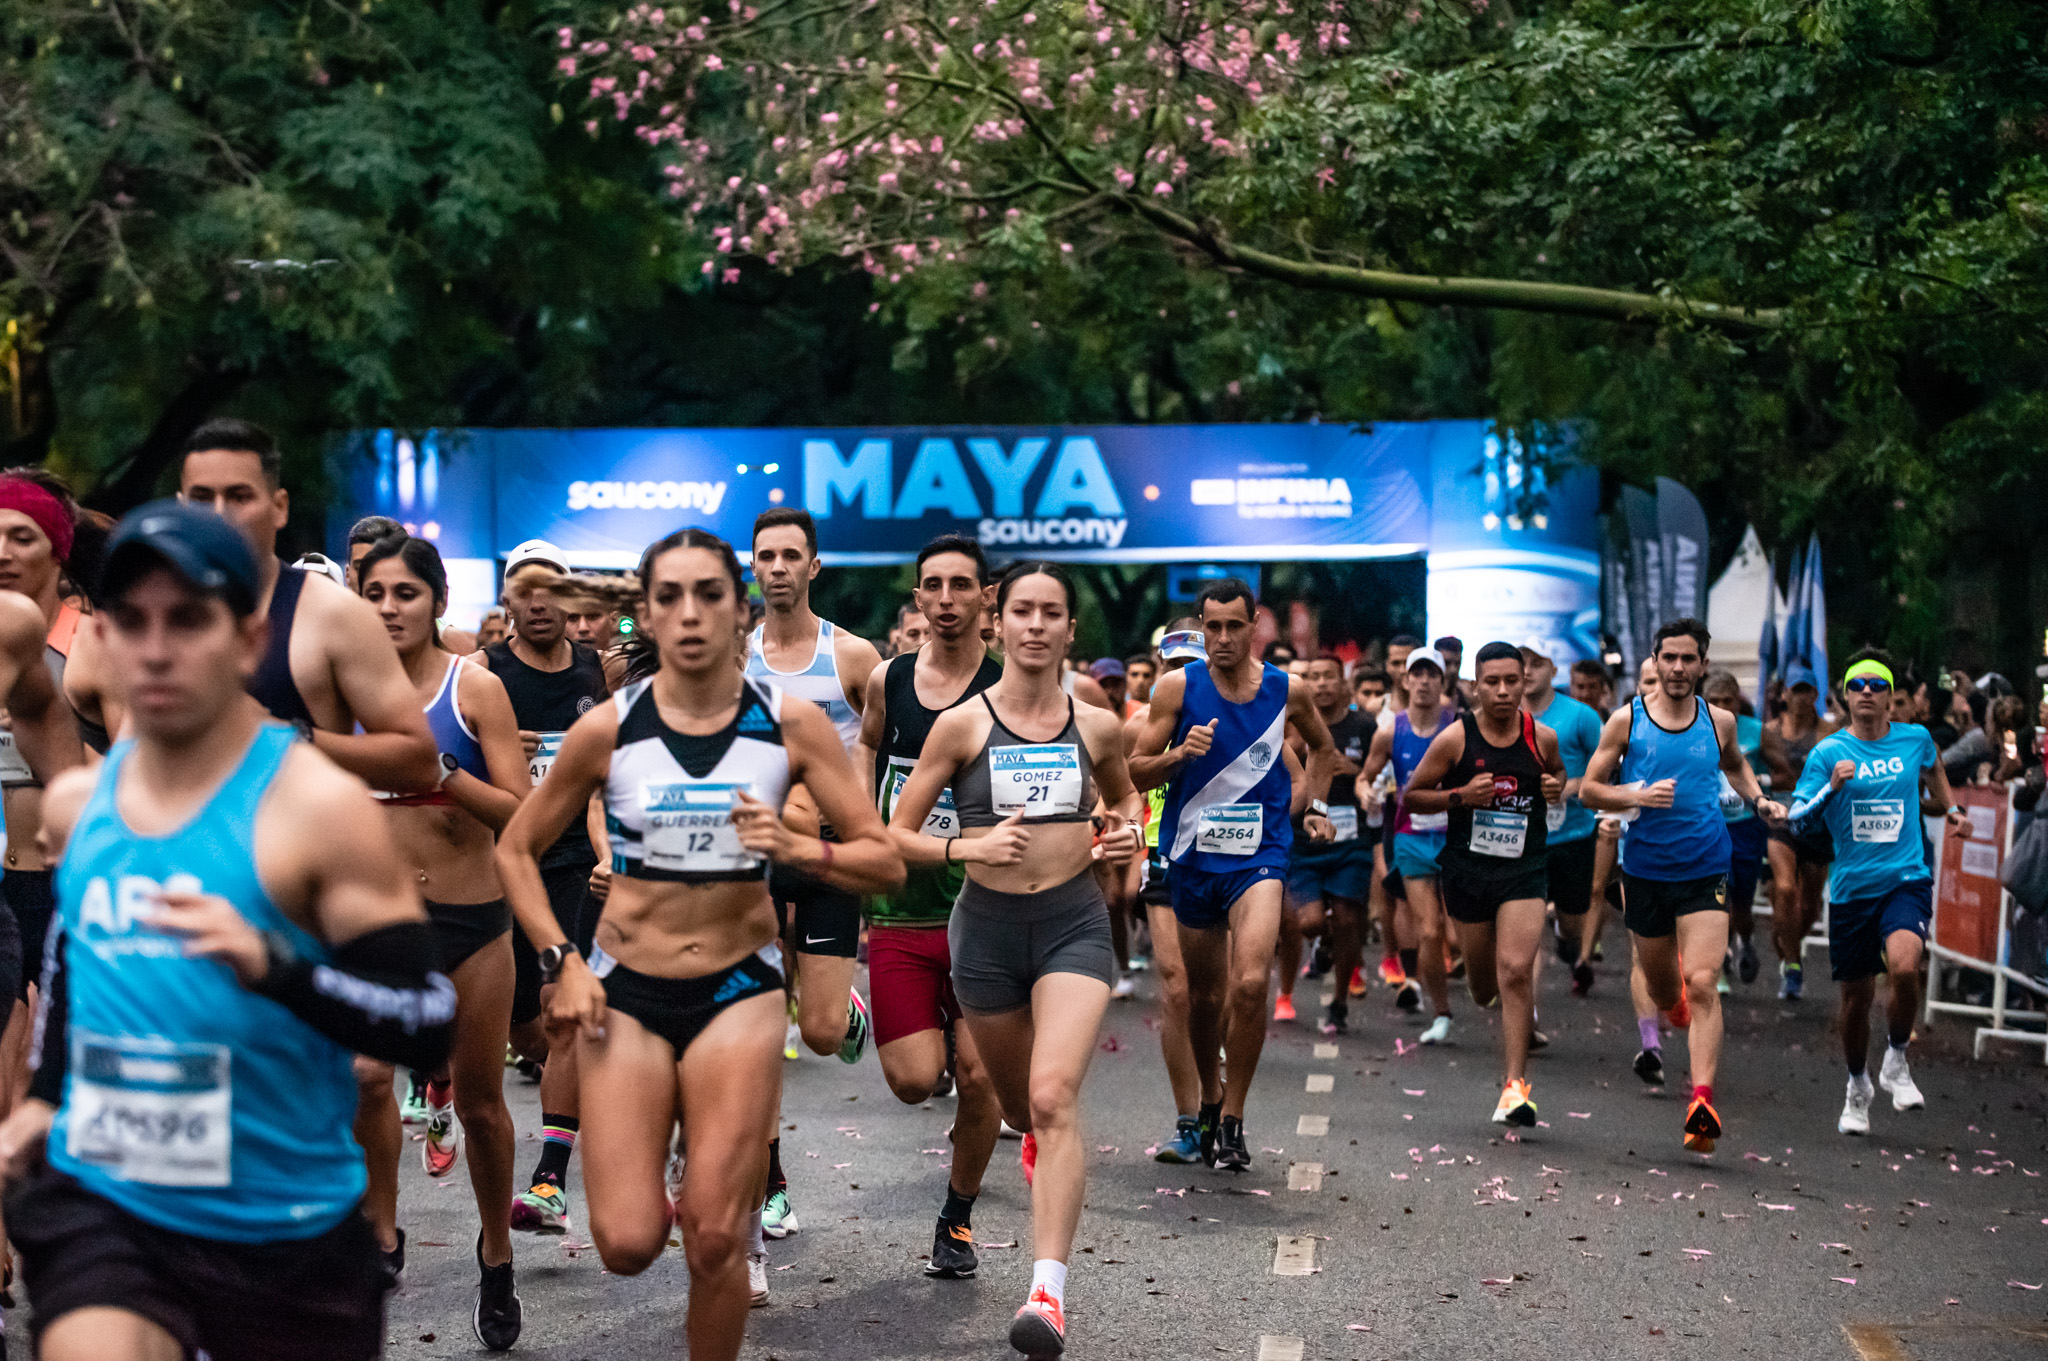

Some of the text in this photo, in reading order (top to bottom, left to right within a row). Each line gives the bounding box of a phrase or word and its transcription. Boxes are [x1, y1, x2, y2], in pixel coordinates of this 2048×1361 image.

[804, 437, 1123, 518] MAYA
[567, 481, 727, 515] saucony
[977, 518, 1128, 548] saucony
[996, 752, 1027, 764] MAYA
[1858, 756, 1904, 779] ARG
[1012, 771, 1063, 782] GOMEZ
[1026, 785, 1049, 802] 21
[1204, 827, 1255, 840] A2564
[1857, 820, 1898, 831] A3697
[688, 832, 714, 851] 12
[1477, 830, 1519, 845] A3456
